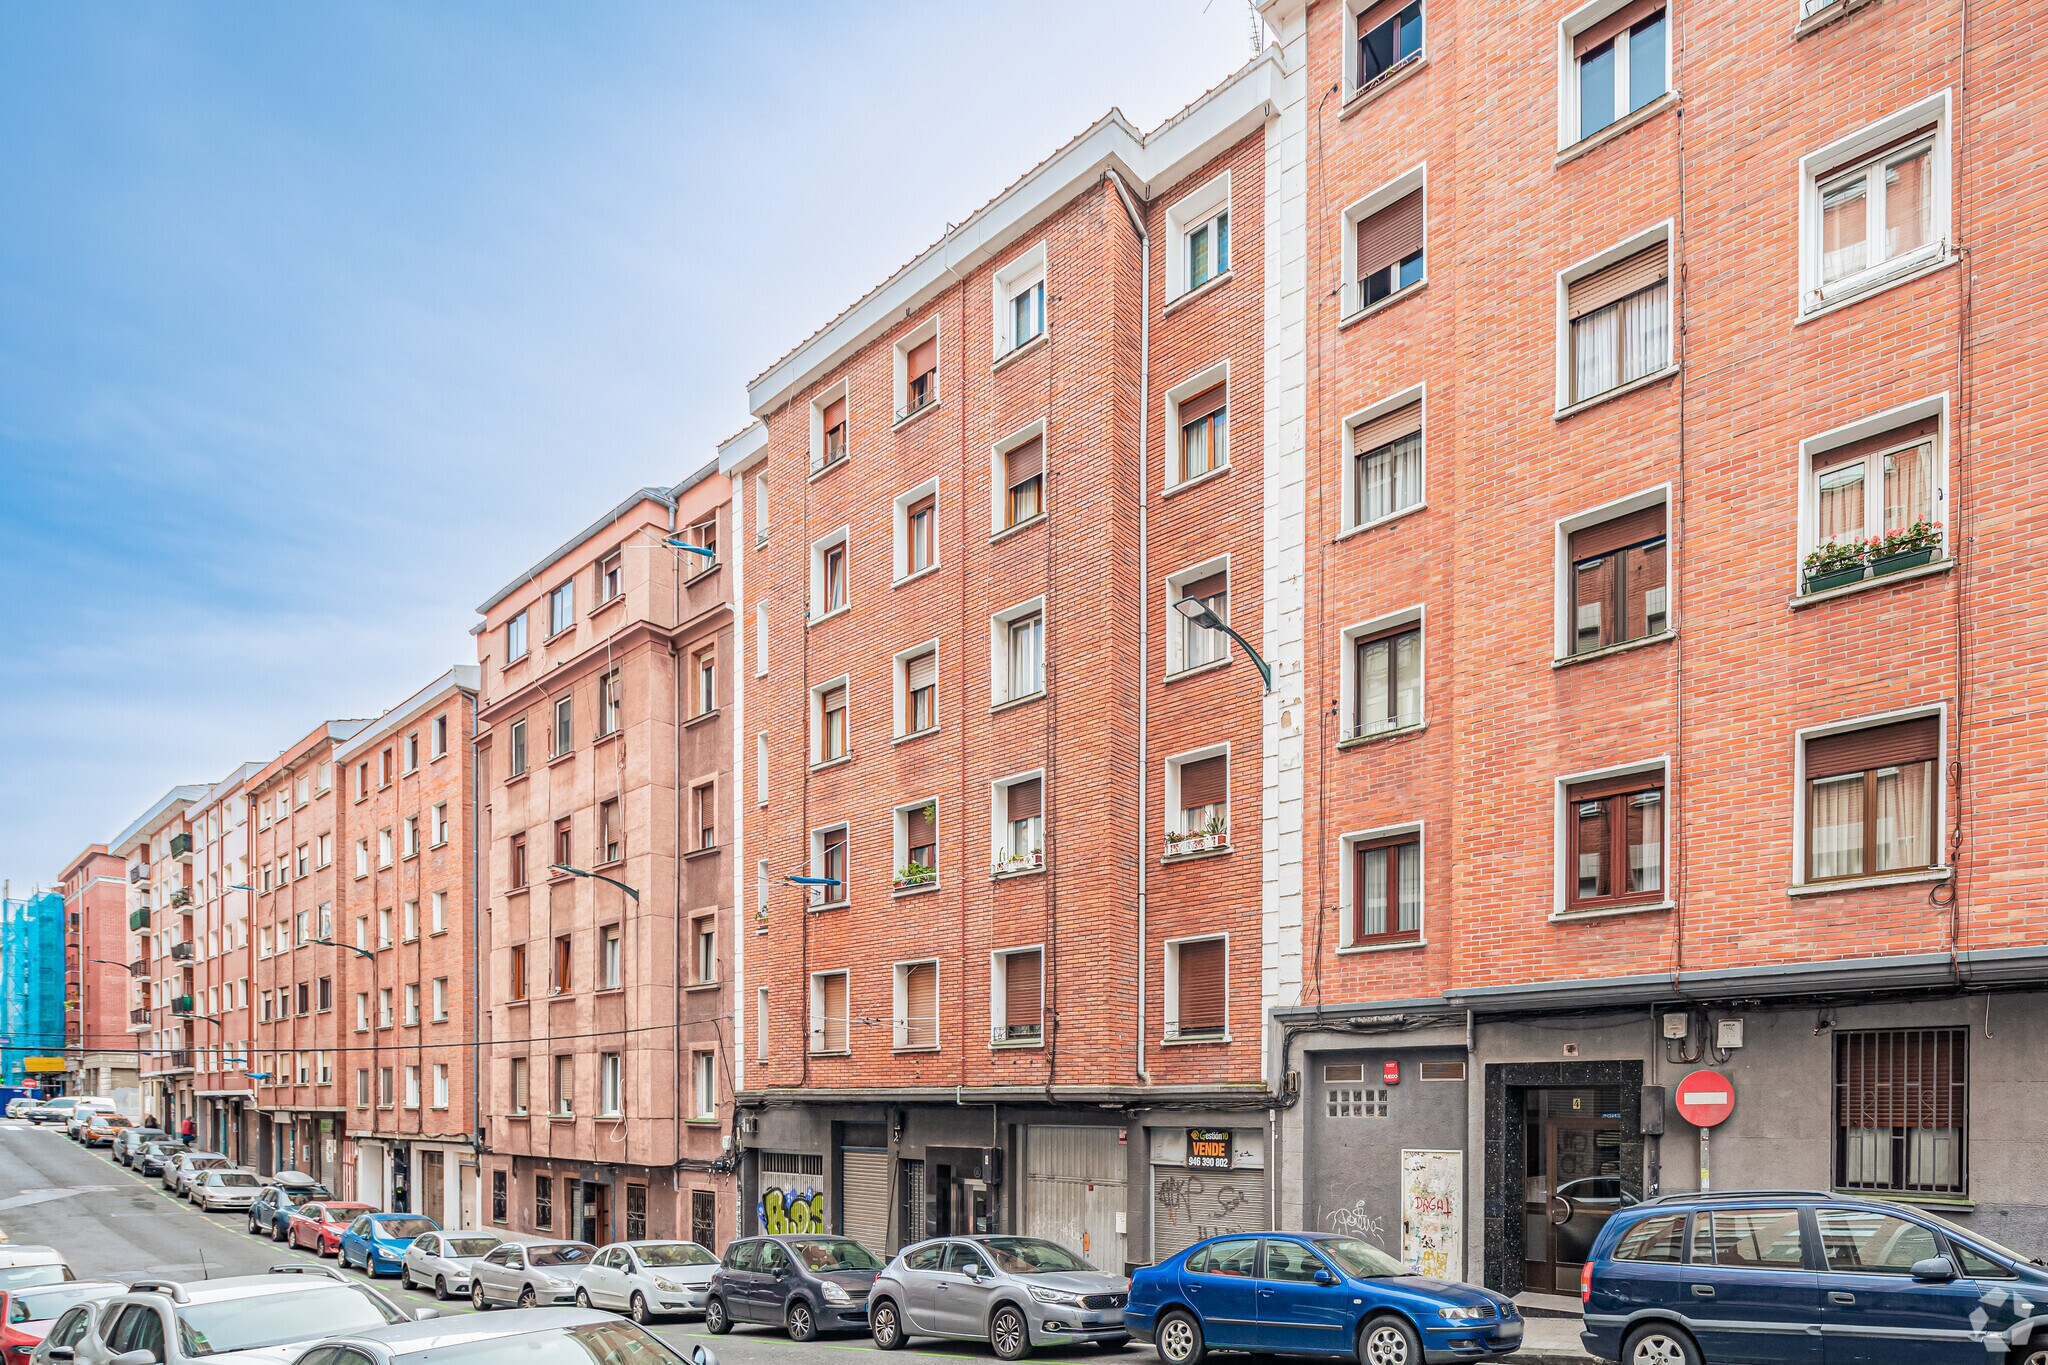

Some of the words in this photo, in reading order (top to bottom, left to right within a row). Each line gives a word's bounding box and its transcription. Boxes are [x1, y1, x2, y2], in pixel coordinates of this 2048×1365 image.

[1192, 1141, 1226, 1157] VENDE
[1188, 1156, 1201, 1166] 946
[1202, 1157, 1215, 1167] 390
[1215, 1158, 1229, 1168] 802
